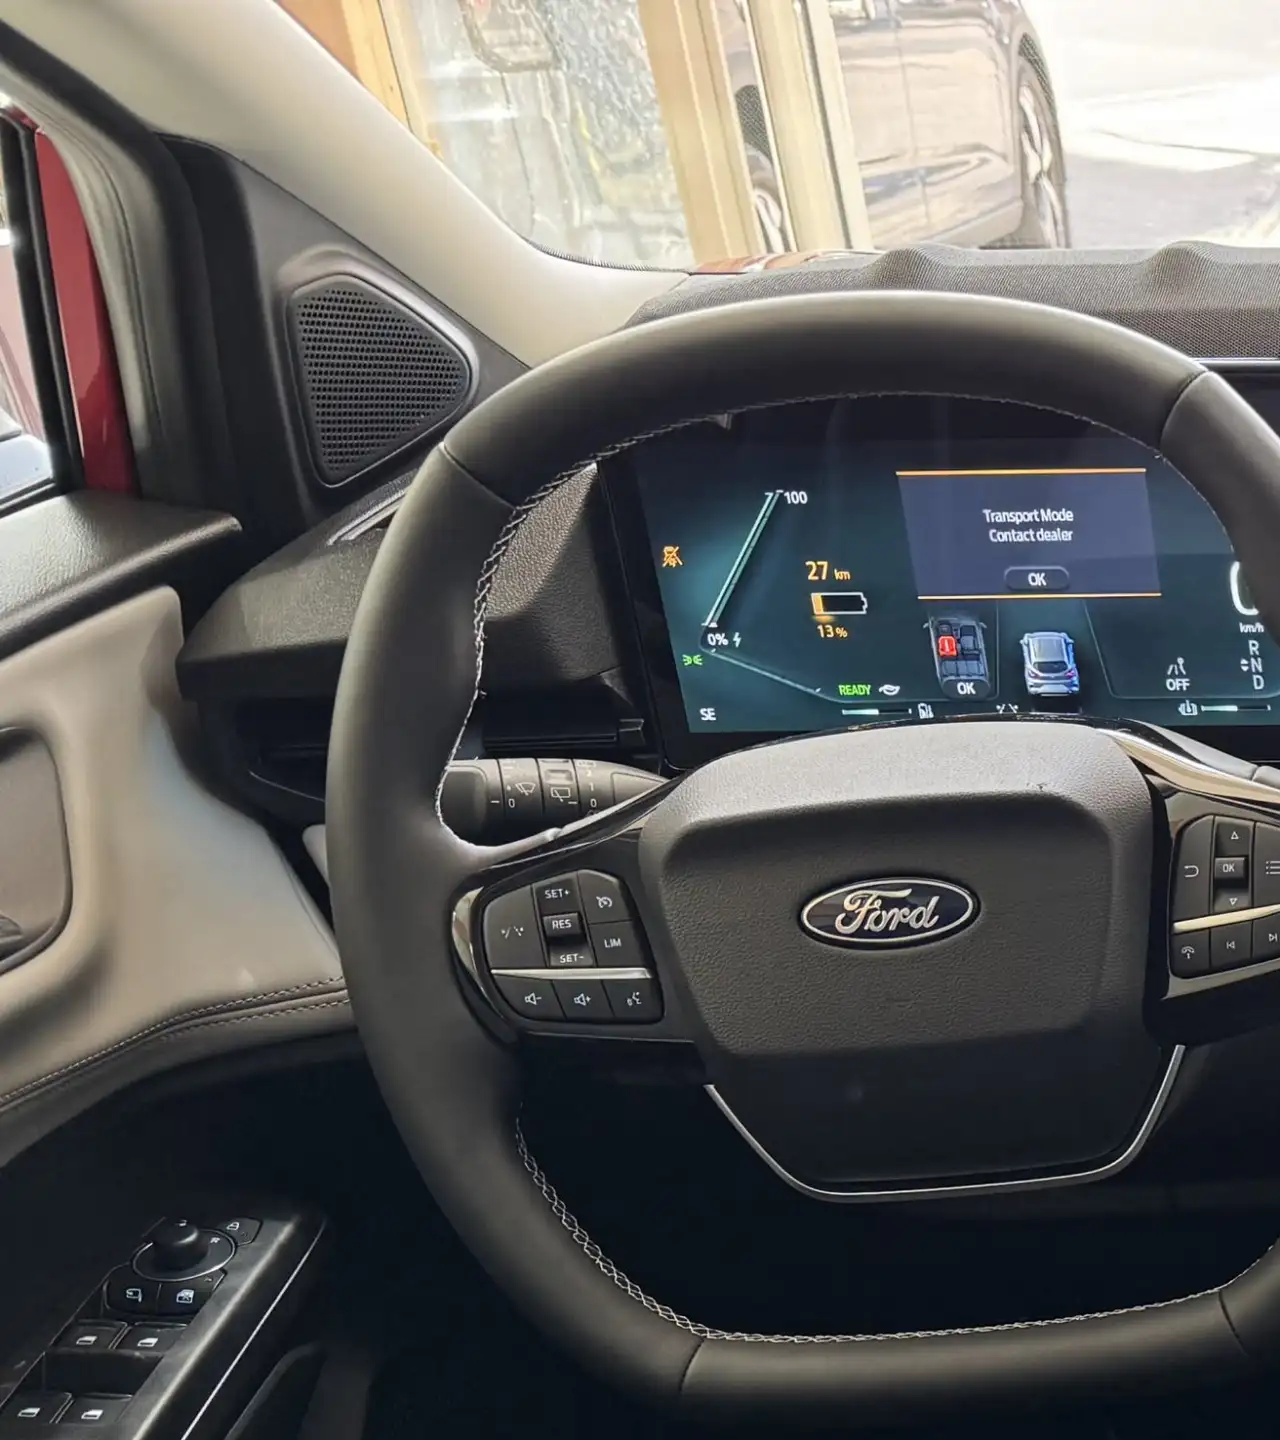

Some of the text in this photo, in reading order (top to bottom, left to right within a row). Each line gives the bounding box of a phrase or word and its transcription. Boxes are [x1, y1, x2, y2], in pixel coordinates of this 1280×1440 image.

[784, 490, 808, 505] 100
[982, 507, 1074, 525] Transport Mode
[988, 527, 1074, 543] Contact dealer
[805, 560, 851, 581] 27 km
[1027, 571, 1047, 587] OK
[1239, 621, 1265, 633] km/h
[707, 634, 729, 646] 0%
[1248, 638, 1260, 656] R
[1250, 656, 1263, 673] N
[957, 681, 976, 696] OK
[1165, 678, 1191, 692] OFF
[1252, 674, 1266, 690] D
[838, 684, 871, 696] READY
[700, 707, 716, 722] SE
[1222, 863, 1236, 873] OK
[544, 888, 570, 899] SET+
[834, 888, 941, 935] Ford
[551, 919, 572, 930] RES
[603, 937, 622, 949] LIM
[559, 953, 585, 964] SET-
